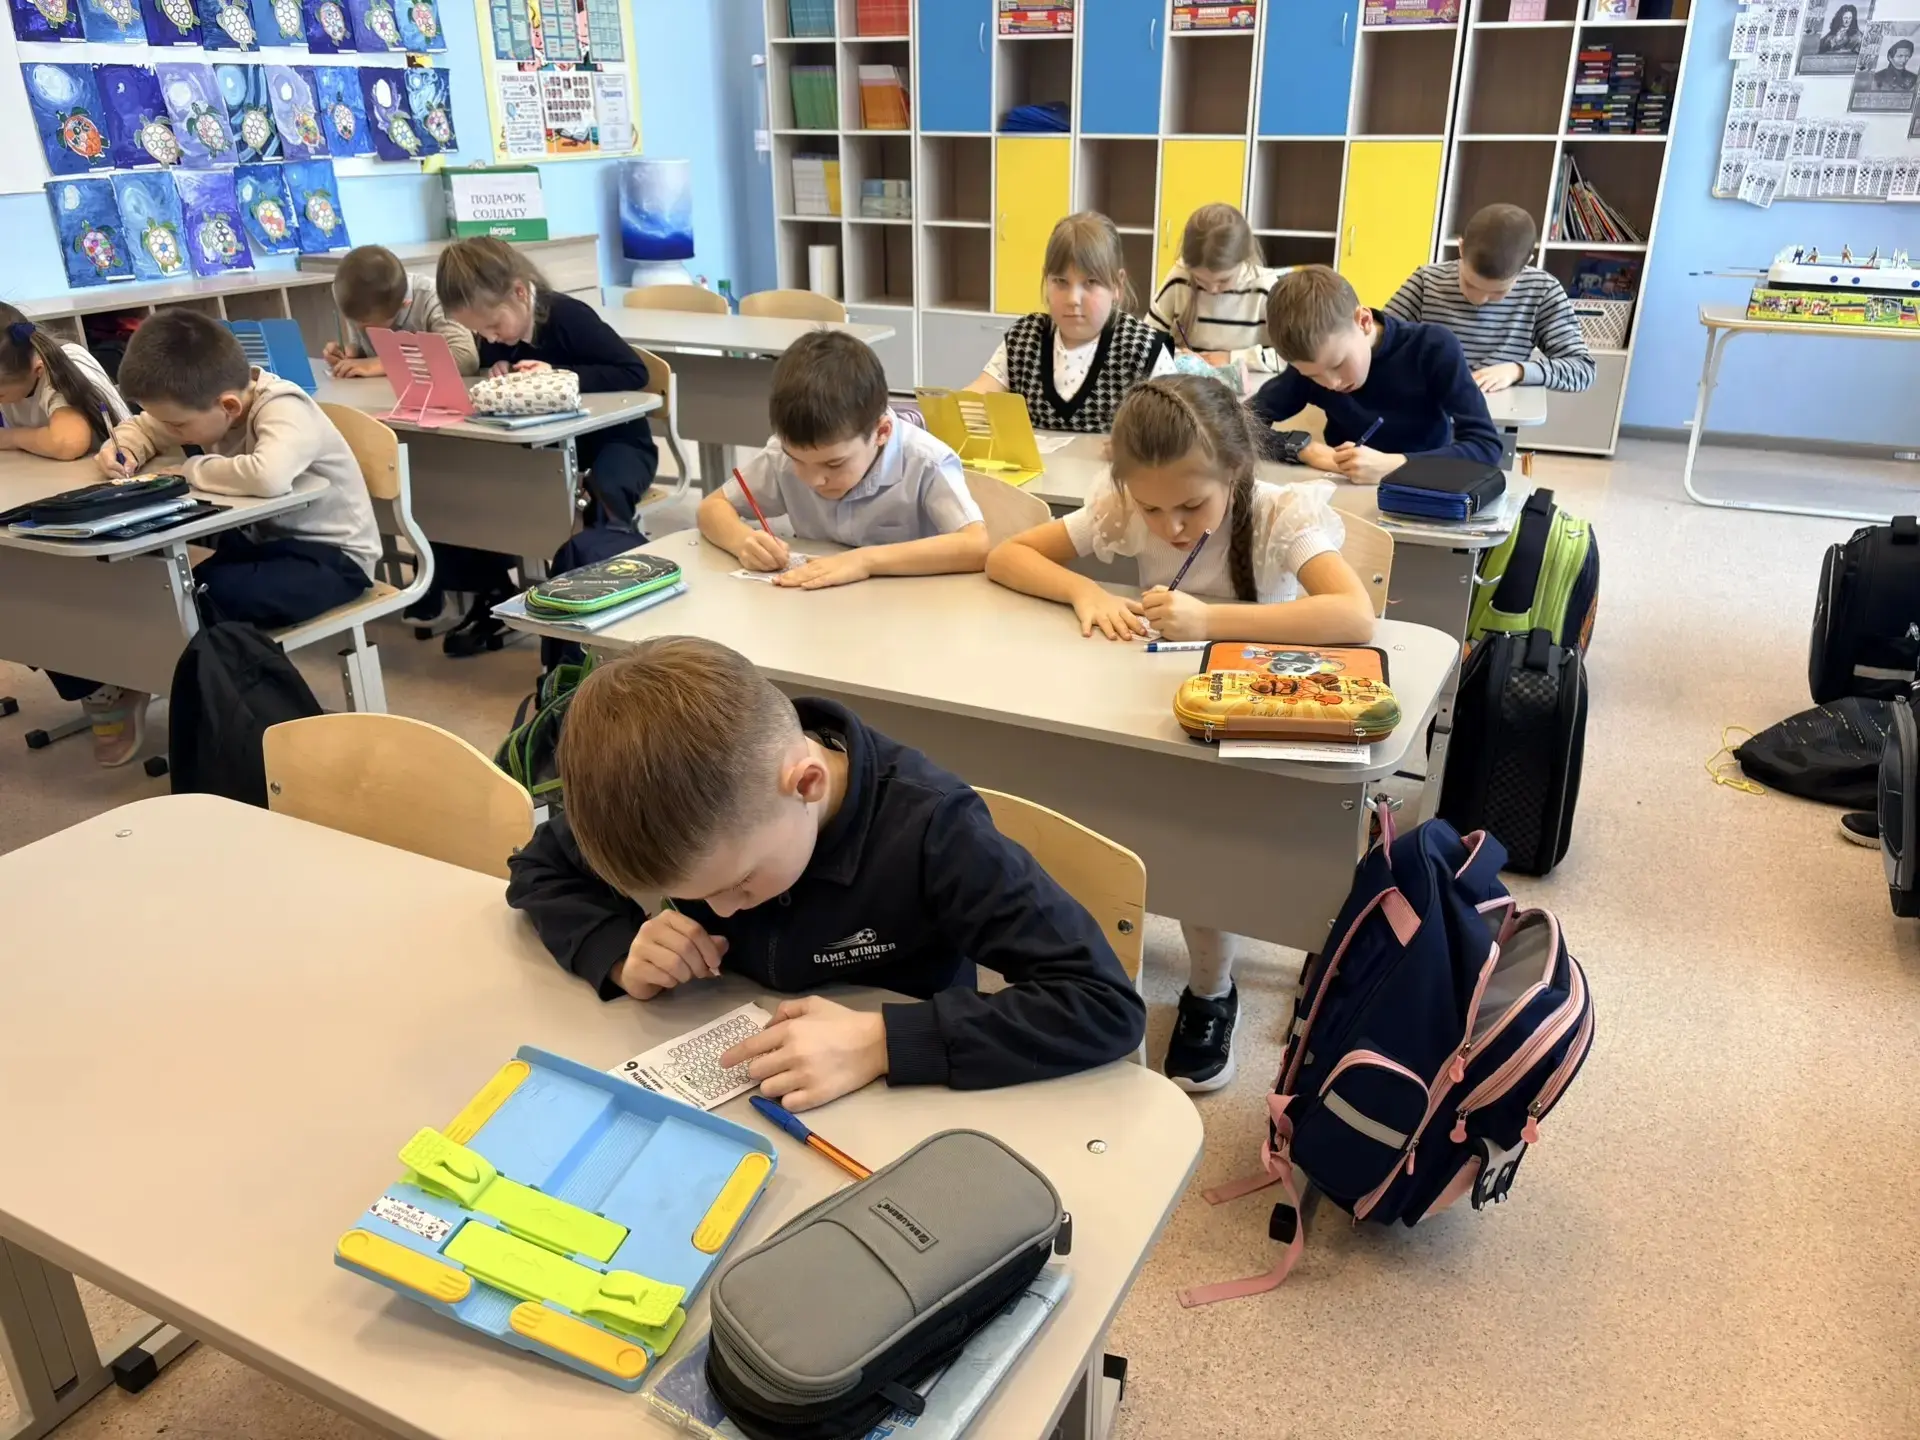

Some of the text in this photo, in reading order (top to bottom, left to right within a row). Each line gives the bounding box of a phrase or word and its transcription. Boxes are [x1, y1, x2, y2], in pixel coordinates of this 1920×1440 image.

[471, 193, 526, 204] ПОДАРОК
[473, 208, 527, 219] СОЛДАТУ
[813, 942, 896, 963] GAME WINNER
[831, 957, 861, 967] FOOTBALL
[624, 1061, 639, 1072] 6
[883, 1203, 921, 1236] BRAUBERG
